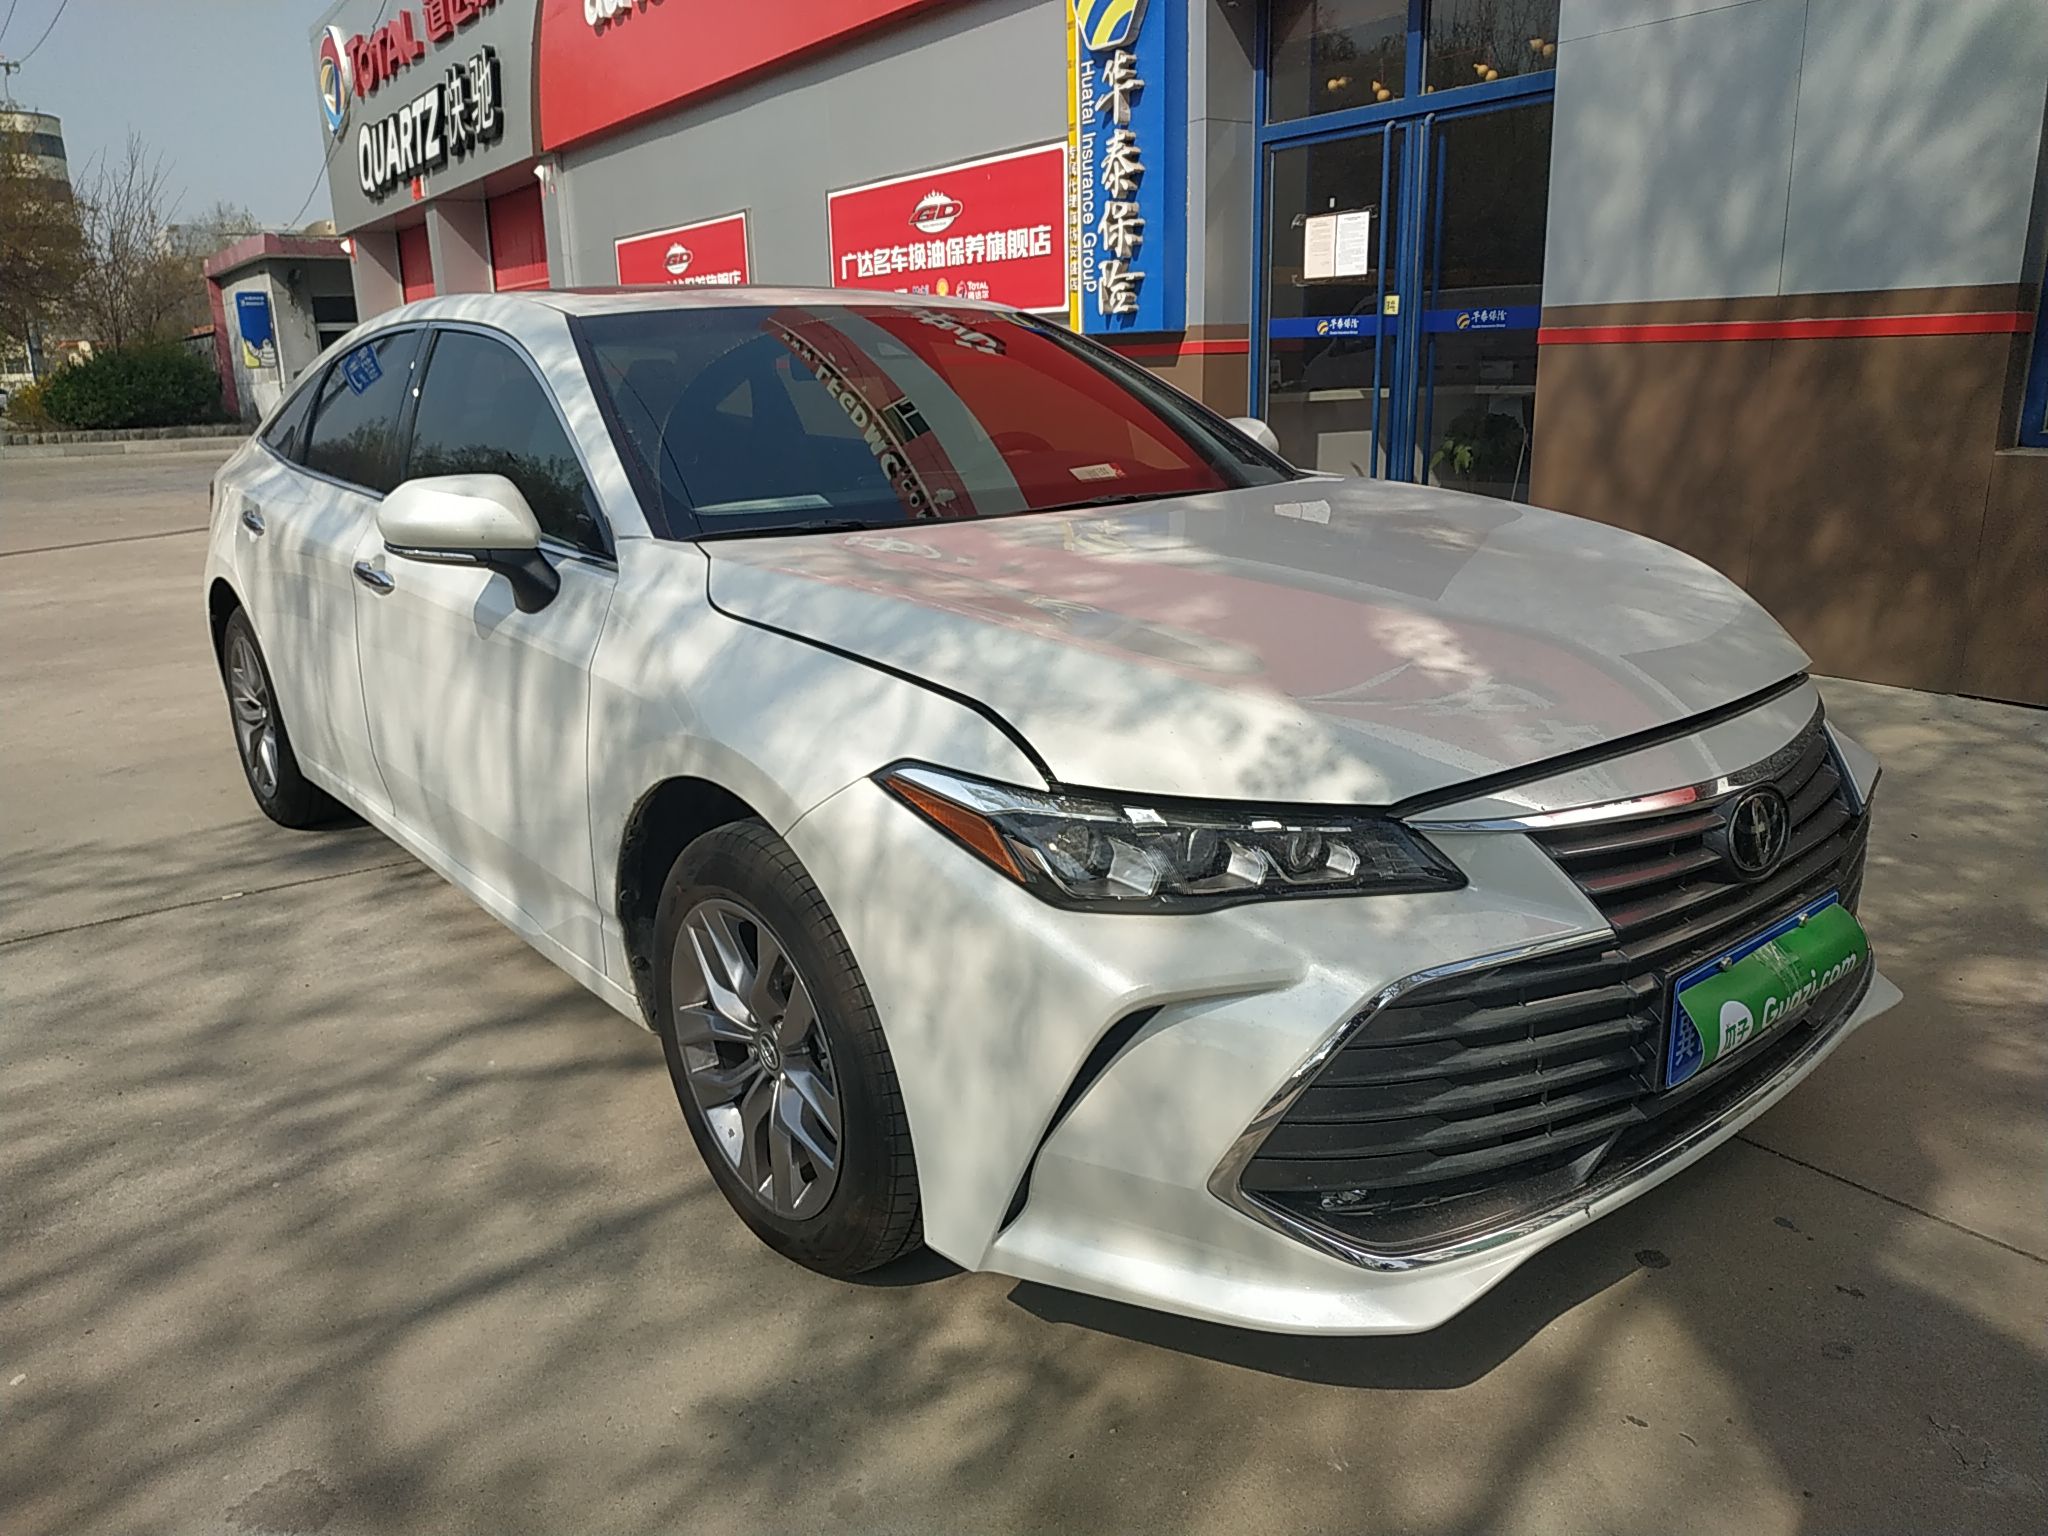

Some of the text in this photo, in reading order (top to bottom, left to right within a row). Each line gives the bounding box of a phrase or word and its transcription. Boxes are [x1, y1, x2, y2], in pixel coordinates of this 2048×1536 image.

[346, 11, 423, 97] TOTAL
[357, 45, 503, 192] QUARTZ 快驰
[1081, 60, 1097, 293] Huatai Insurance Group
[1095, 49, 1146, 316] 华泰保险
[841, 224, 1052, 281] 广达名车换油保养旗舰店
[1761, 952, 1857, 1029] Guazi.com
